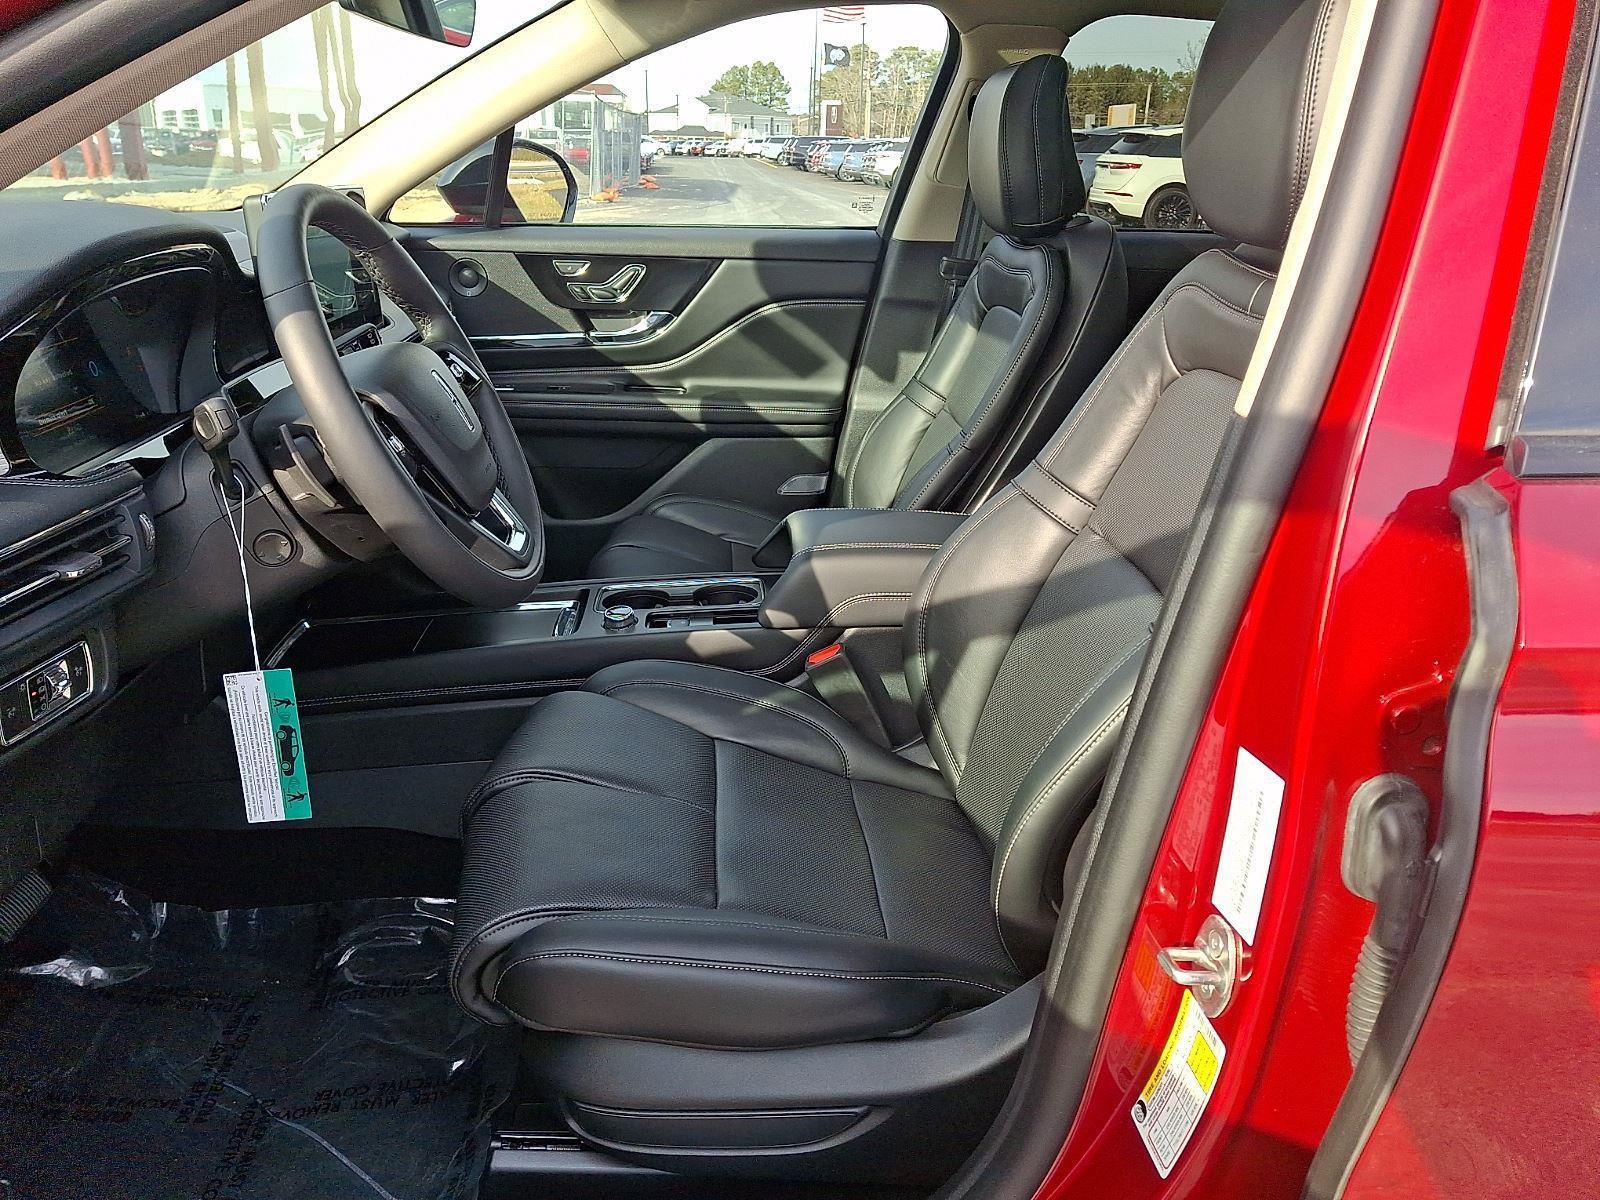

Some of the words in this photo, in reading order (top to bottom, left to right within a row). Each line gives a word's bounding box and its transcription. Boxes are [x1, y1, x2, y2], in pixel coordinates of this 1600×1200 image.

[316, 1086, 369, 1101] COVER
[1145, 1084, 1155, 1099] TIRE
[1154, 1069, 1162, 1083] AND
[349, 1096, 398, 1110] MUST
[228, 1151, 255, 1188] MUST
